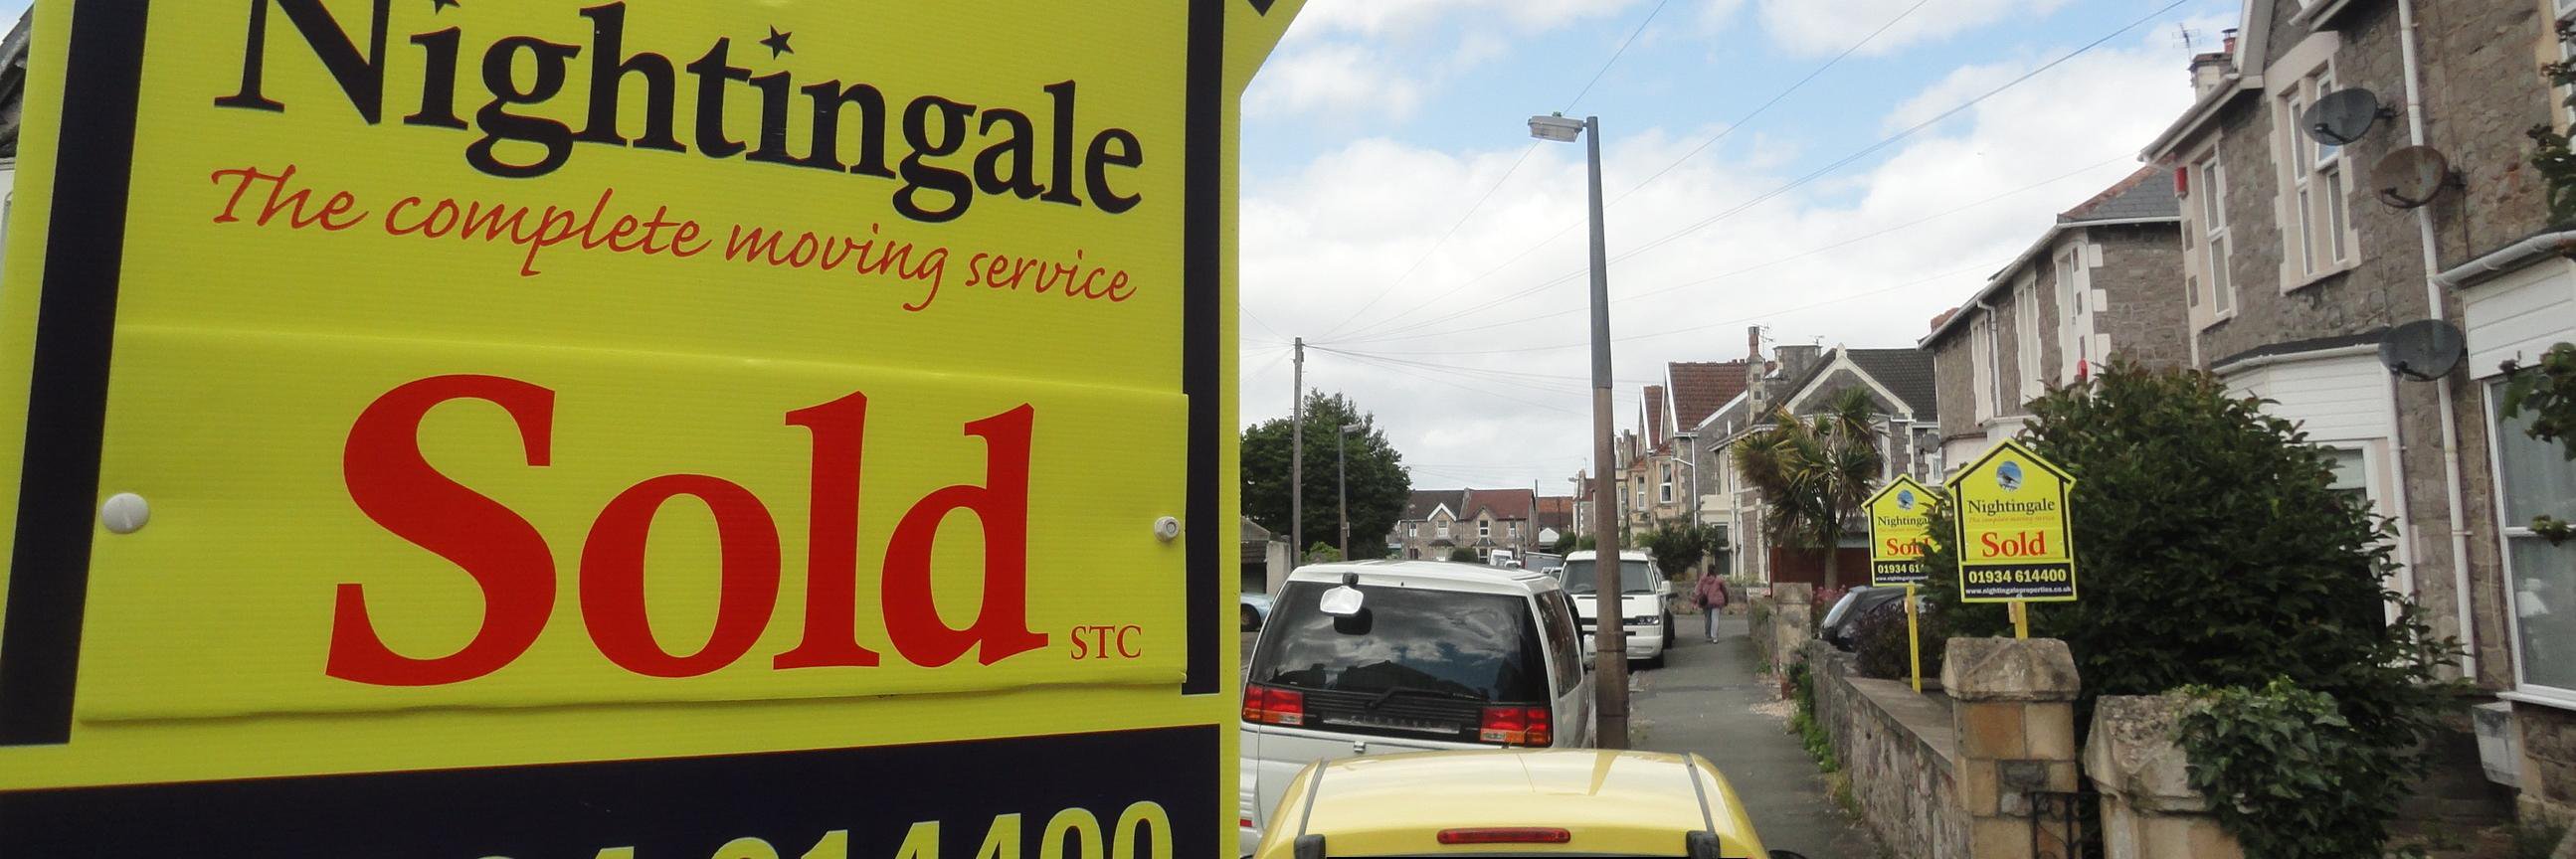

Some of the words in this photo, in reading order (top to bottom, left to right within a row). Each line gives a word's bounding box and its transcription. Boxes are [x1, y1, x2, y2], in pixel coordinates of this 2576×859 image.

[213, 0, 1144, 224] Nightingale
[211, 164, 368, 233] The
[384, 188, 712, 277] complete
[725, 223, 949, 312] moving
[965, 249, 1137, 303] service
[1967, 498, 2055, 516] Nightingale
[323, 372, 1051, 688] Sold
[1069, 624, 1142, 662] STC
[1877, 516, 1930, 527] Nightinga
[1980, 530, 2047, 558] Sold
[1877, 564, 1907, 574] 01934
[1968, 570, 2012, 584] 01934
[2014, 568, 2067, 583] 614400
